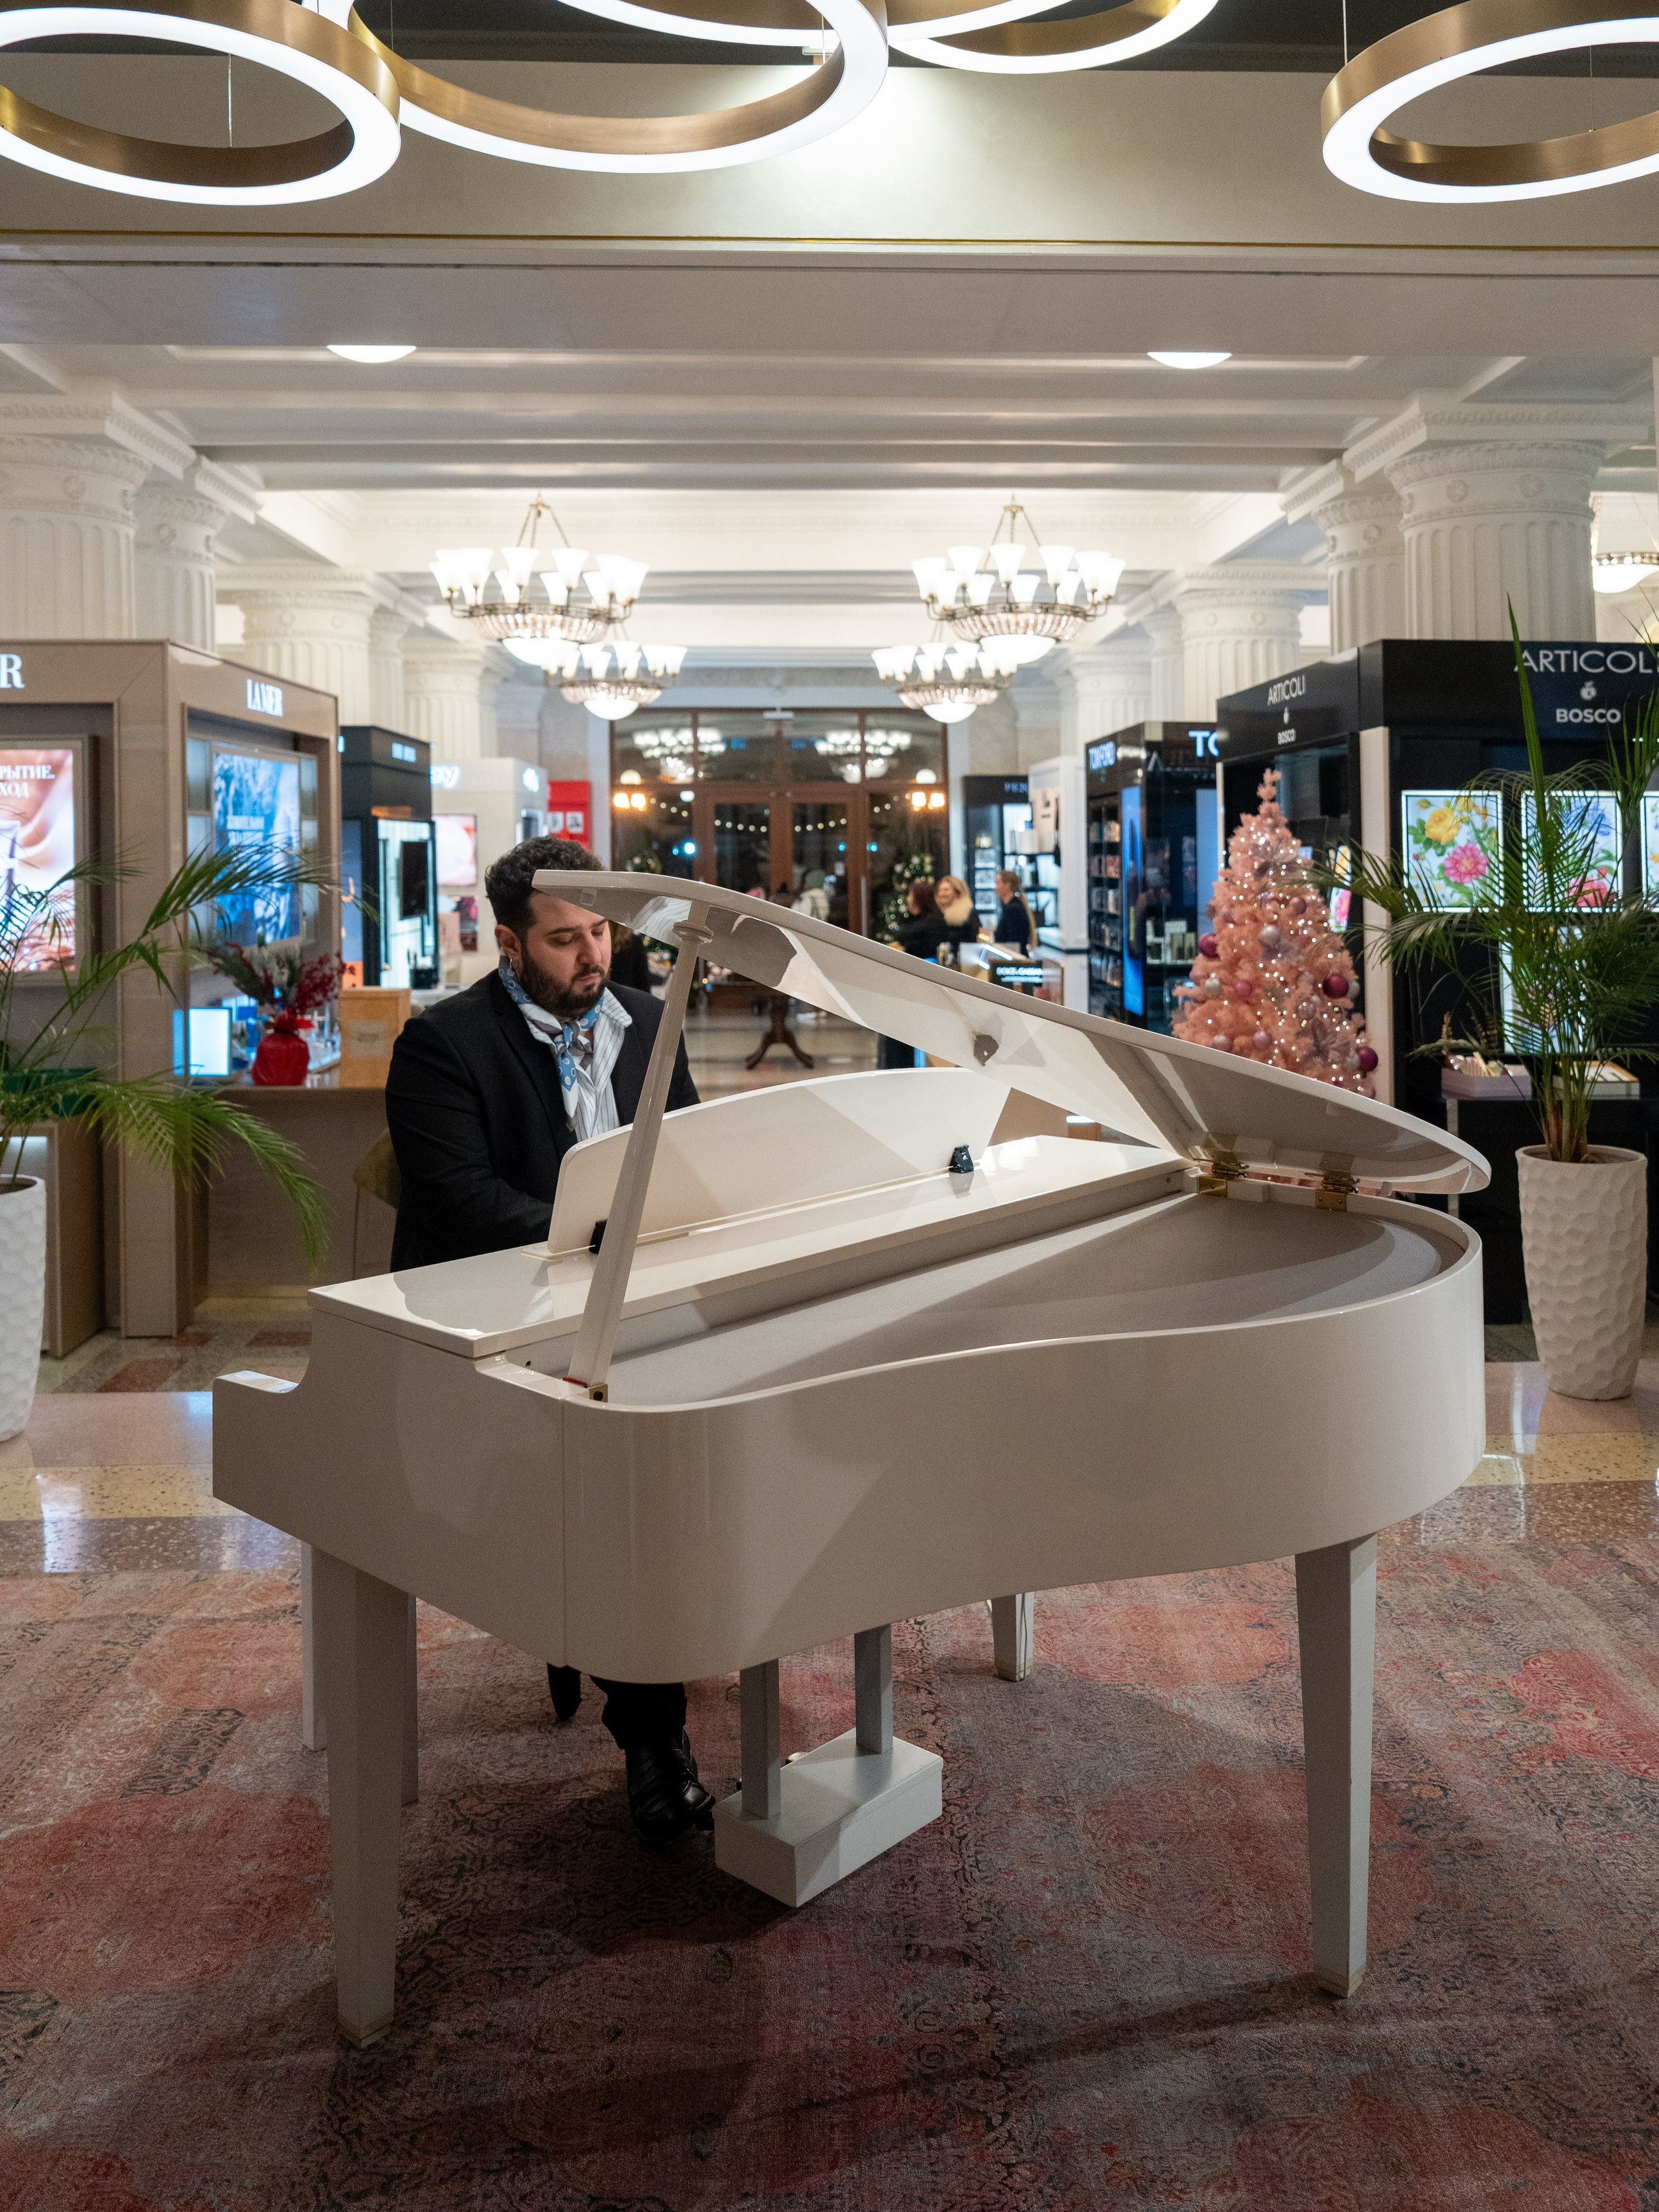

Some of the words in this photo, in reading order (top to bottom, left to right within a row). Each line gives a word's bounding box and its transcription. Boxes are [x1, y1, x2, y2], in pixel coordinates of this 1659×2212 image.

[1267, 674, 1306, 706] ARTICOLI
[1555, 708, 1622, 724] BOSCO
[1277, 728, 1296, 745] BOSCO
